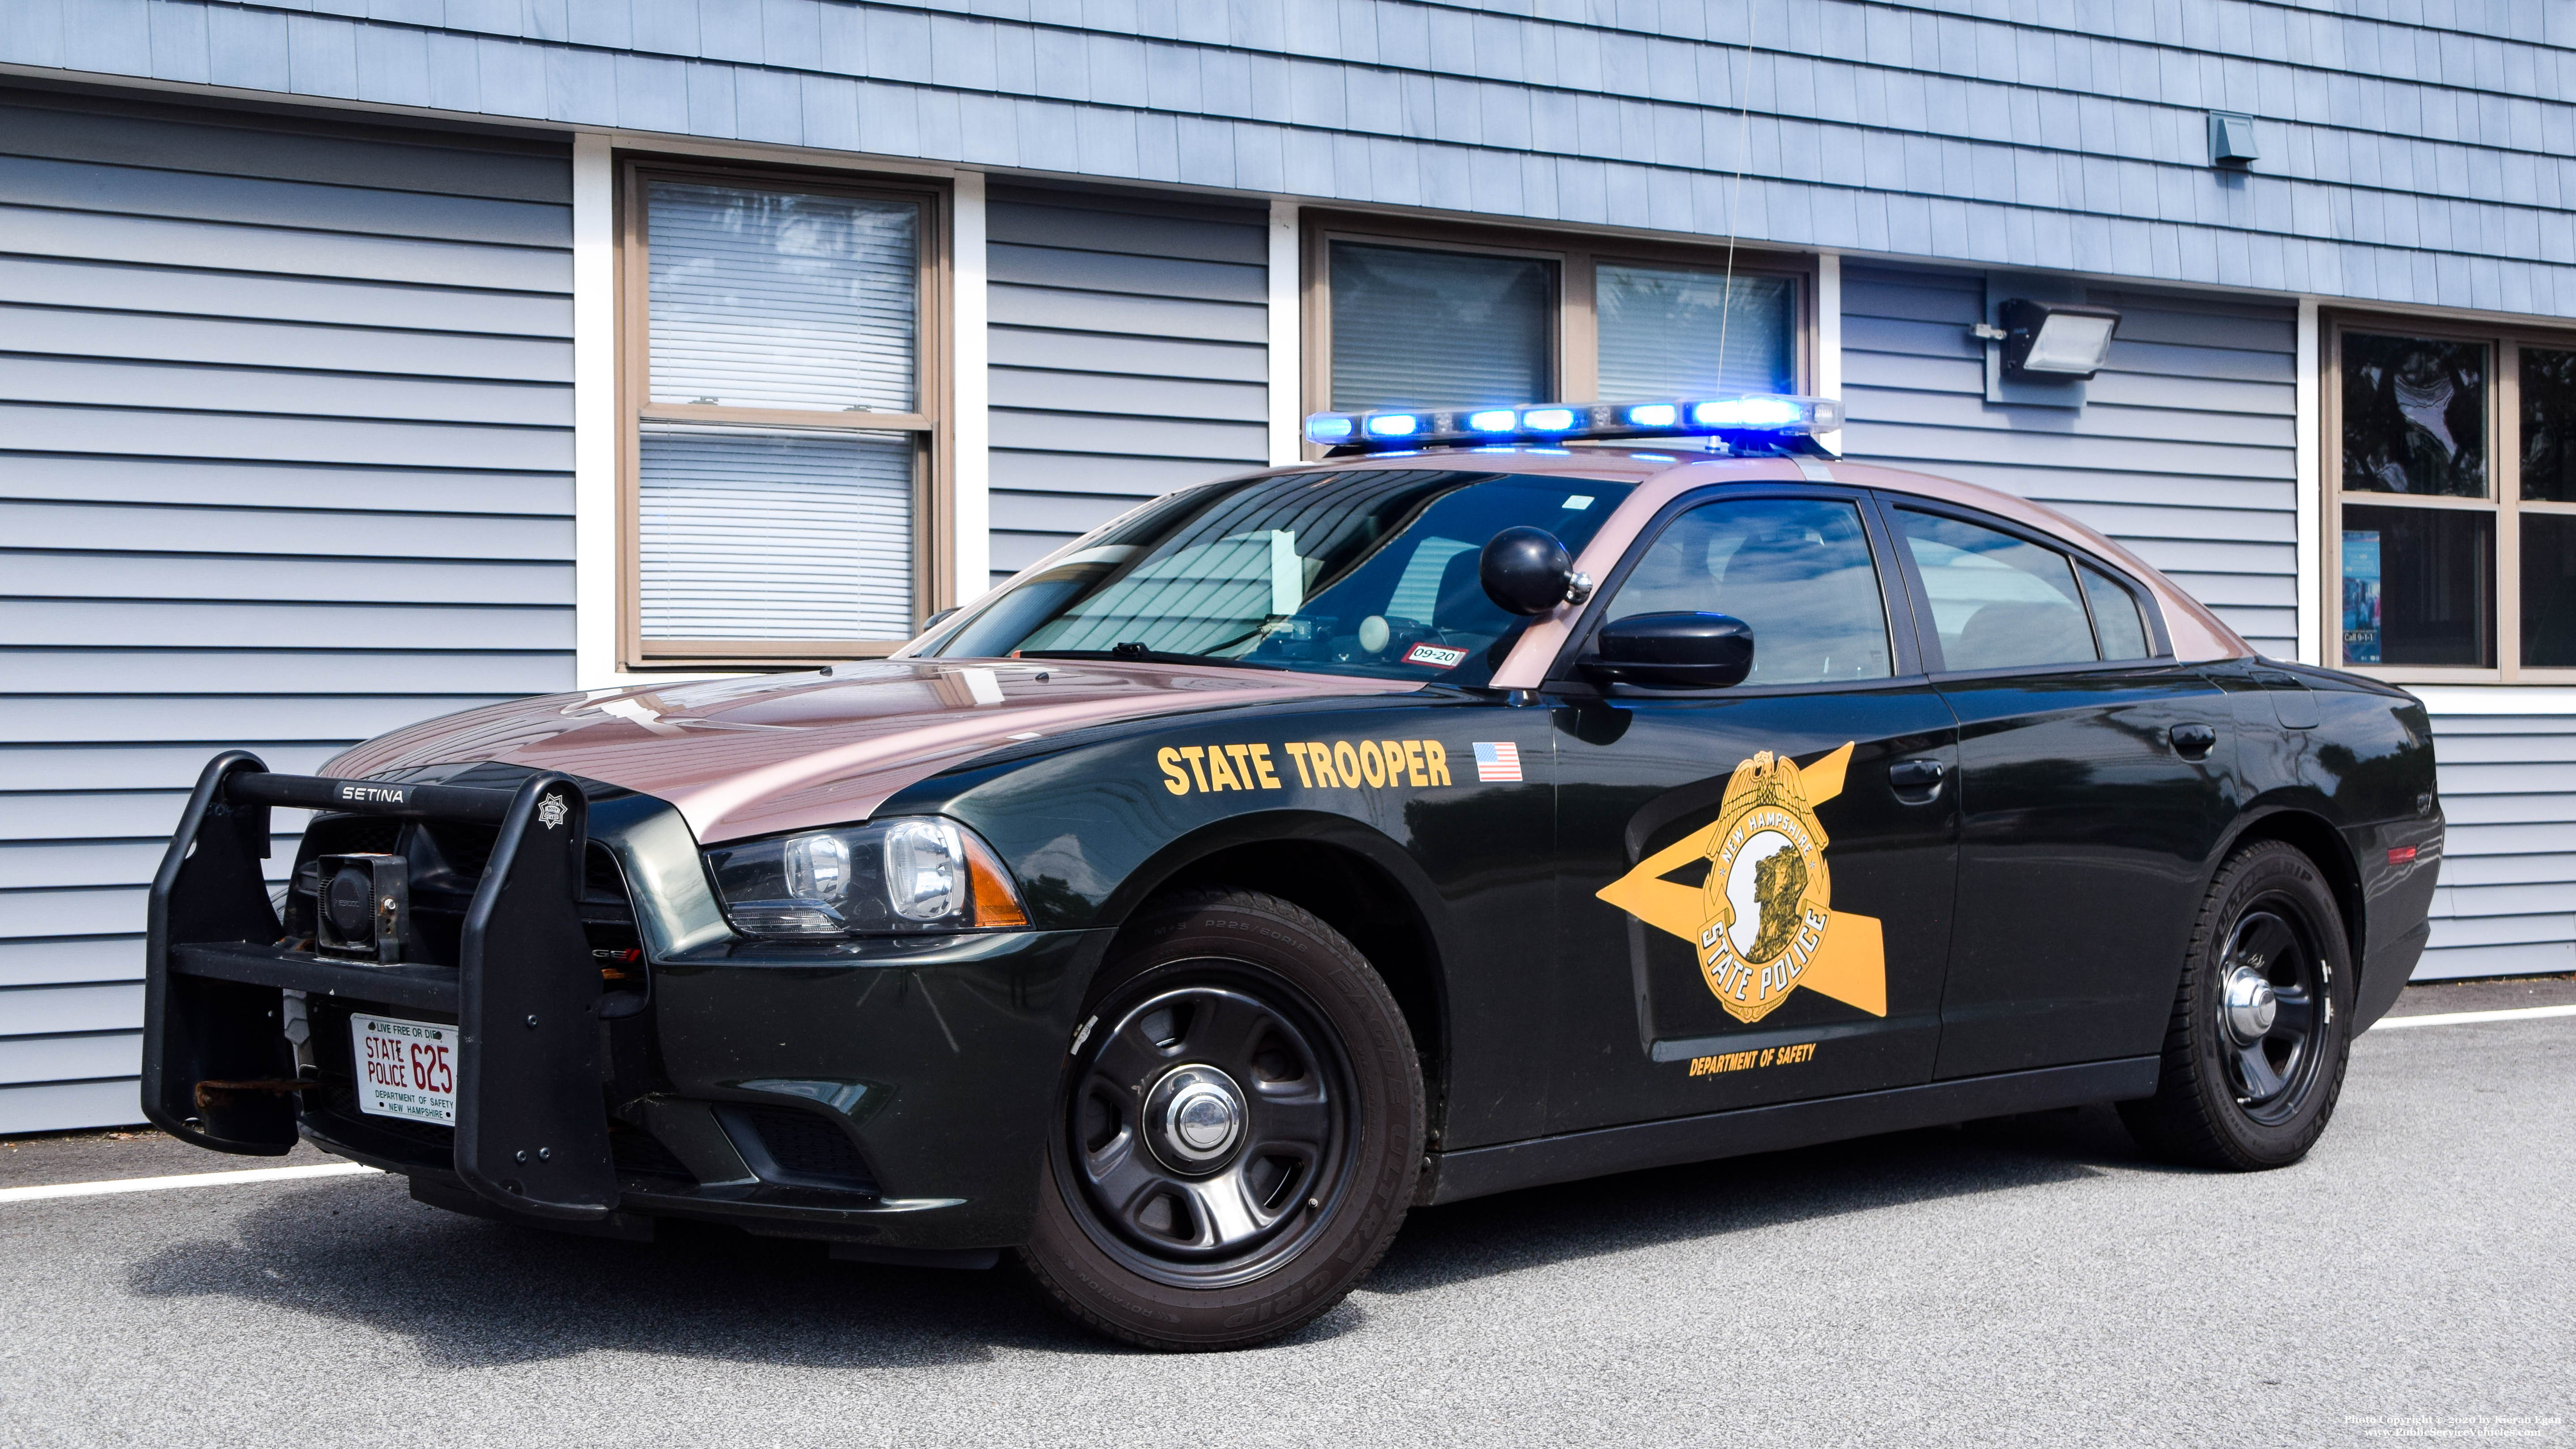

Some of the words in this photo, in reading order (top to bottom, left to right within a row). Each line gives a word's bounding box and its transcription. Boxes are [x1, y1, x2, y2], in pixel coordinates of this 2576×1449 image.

[1414, 648, 1455, 661] 09-20
[1157, 743, 1281, 796] STATE
[1285, 740, 1452, 788] TROOPER
[343, 787, 403, 803] SETINA
[1722, 825, 1745, 863] NEW
[1748, 812, 1813, 858] HAMPSHIRE
[1703, 919, 1753, 1000] STATE
[1759, 909, 1826, 1000] POLICE
[377, 1023, 391, 1034] LIVE
[393, 1026, 410, 1036] FREE
[412, 1028, 422, 1038] OR
[366, 1037, 404, 1062] STATE
[411, 1043, 452, 1094] 625
[368, 1061, 407, 1088] POLICE
[1689, 1051, 1758, 1076] DEPARTMENT
[1760, 1049, 1774, 1067] OF
[1777, 1043, 1816, 1064] SAFETY
[375, 1090, 415, 1103] DEPARTMENT
[430, 1098, 453, 1109] SAFETY
[389, 1103, 402, 1112] NEW
[407, 1104, 443, 1119] HAMPSHIRE
[1076, 1272, 1153, 1318] ROTATION
[1224, 1271, 1331, 1328] GRIP
